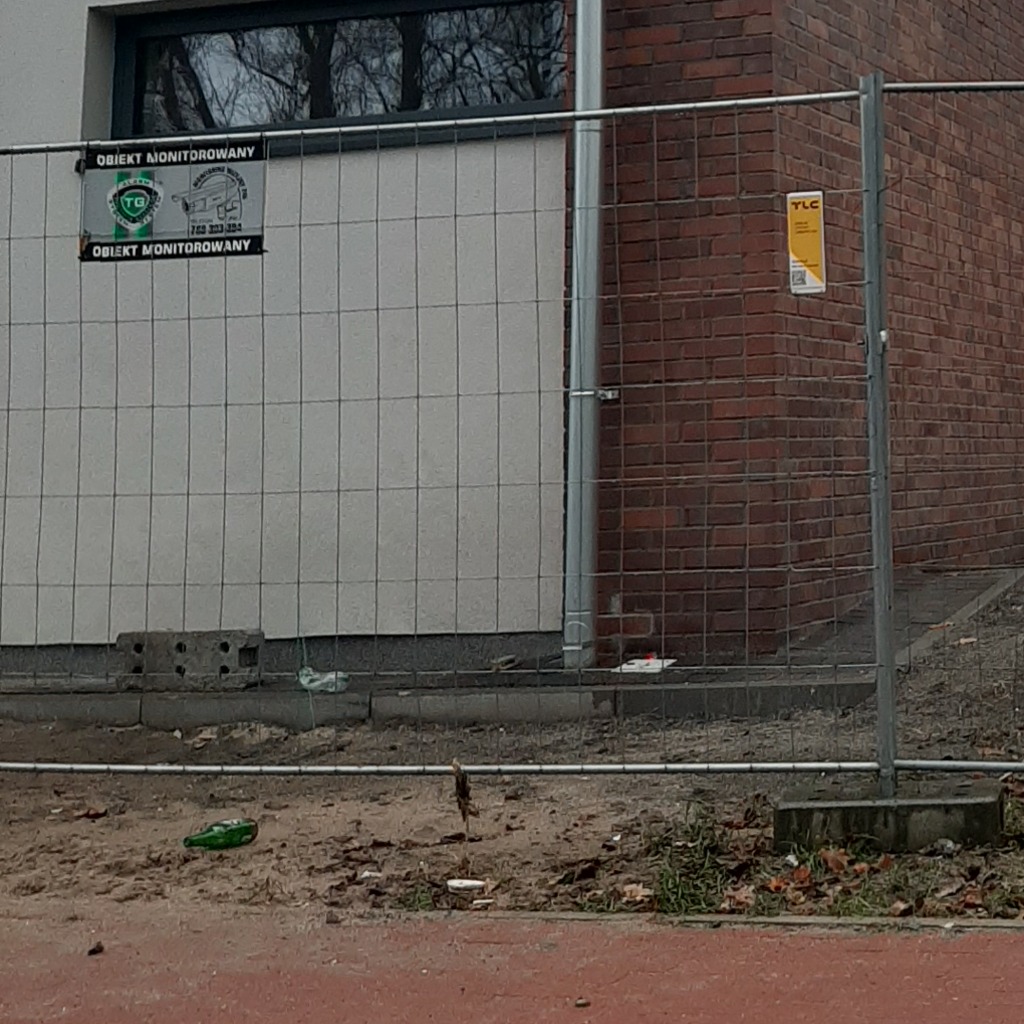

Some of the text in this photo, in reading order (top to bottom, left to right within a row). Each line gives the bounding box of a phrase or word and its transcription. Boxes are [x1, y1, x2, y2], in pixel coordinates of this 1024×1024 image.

[96, 146, 255, 166] OBIEKT MONITOROWANY
[123, 196, 146, 208] TG
[790, 200, 819, 210] TLC
[92, 239, 251, 258] OBIEKT MONITOROWANY
